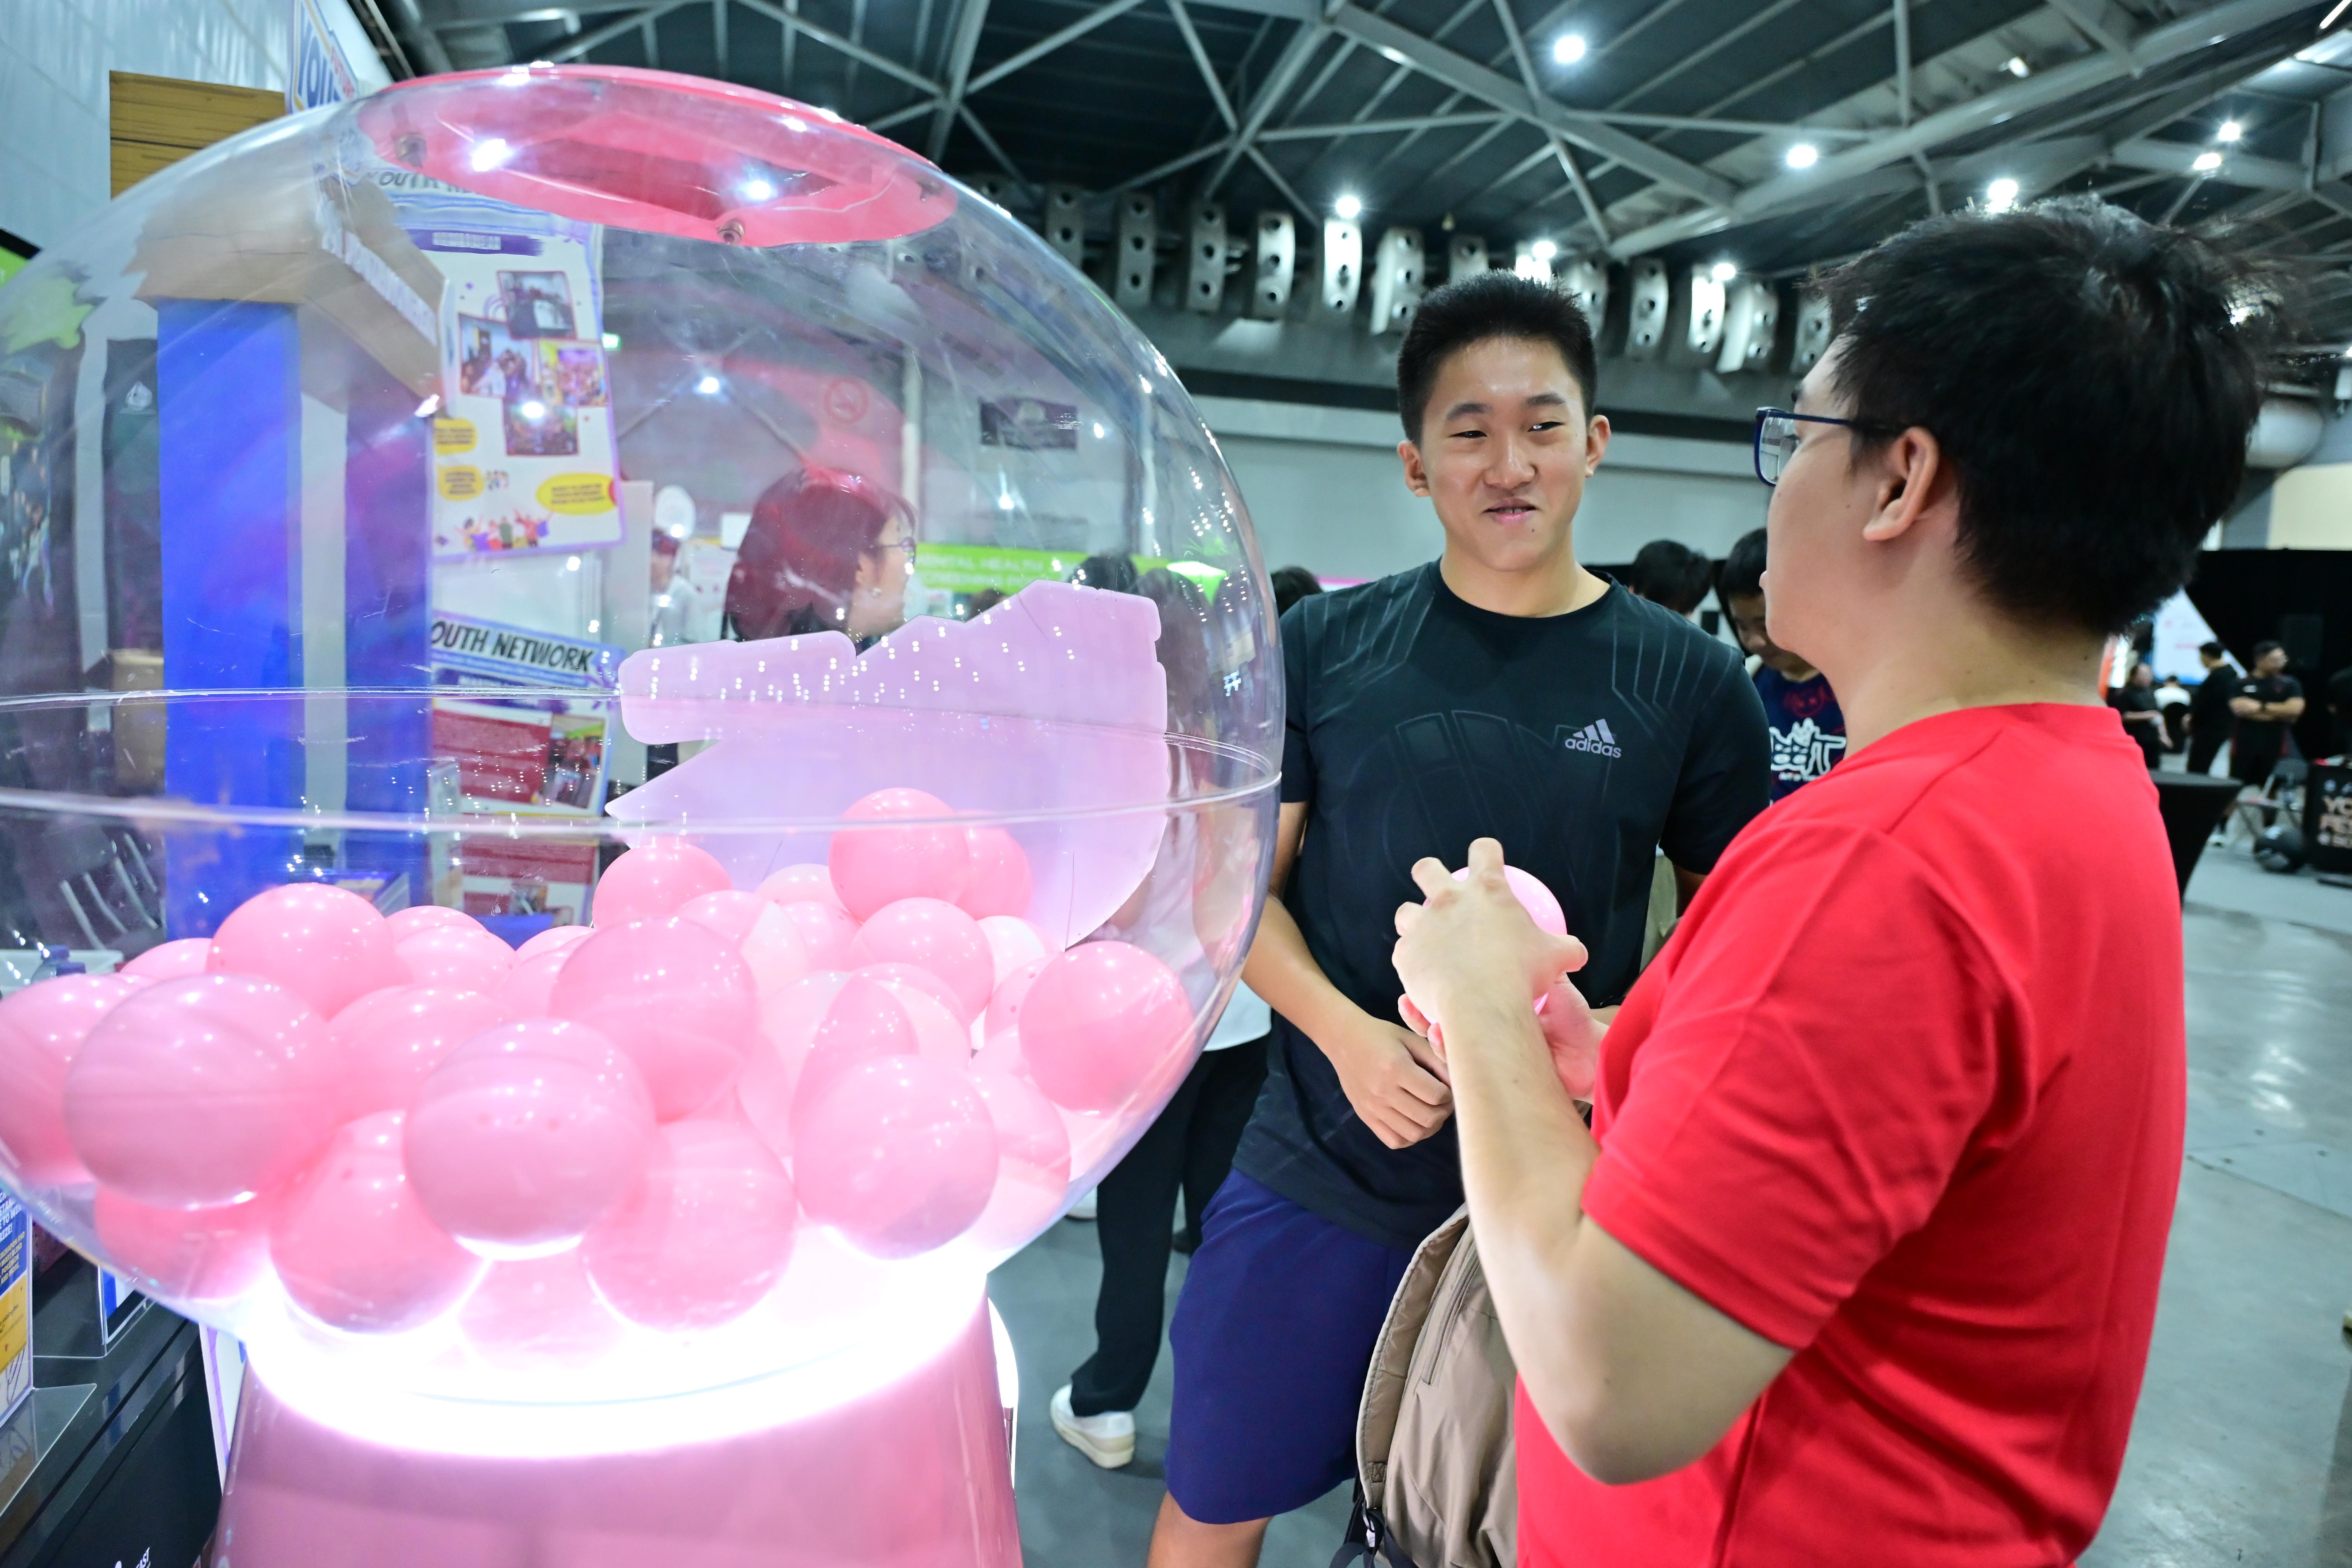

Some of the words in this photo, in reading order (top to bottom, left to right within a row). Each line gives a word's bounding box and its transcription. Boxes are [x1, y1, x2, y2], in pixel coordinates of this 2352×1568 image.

[491, 633, 595, 672] NETWORK
[1565, 738, 1622, 758] adidas
[3, 1213, 10, 1226] TO
